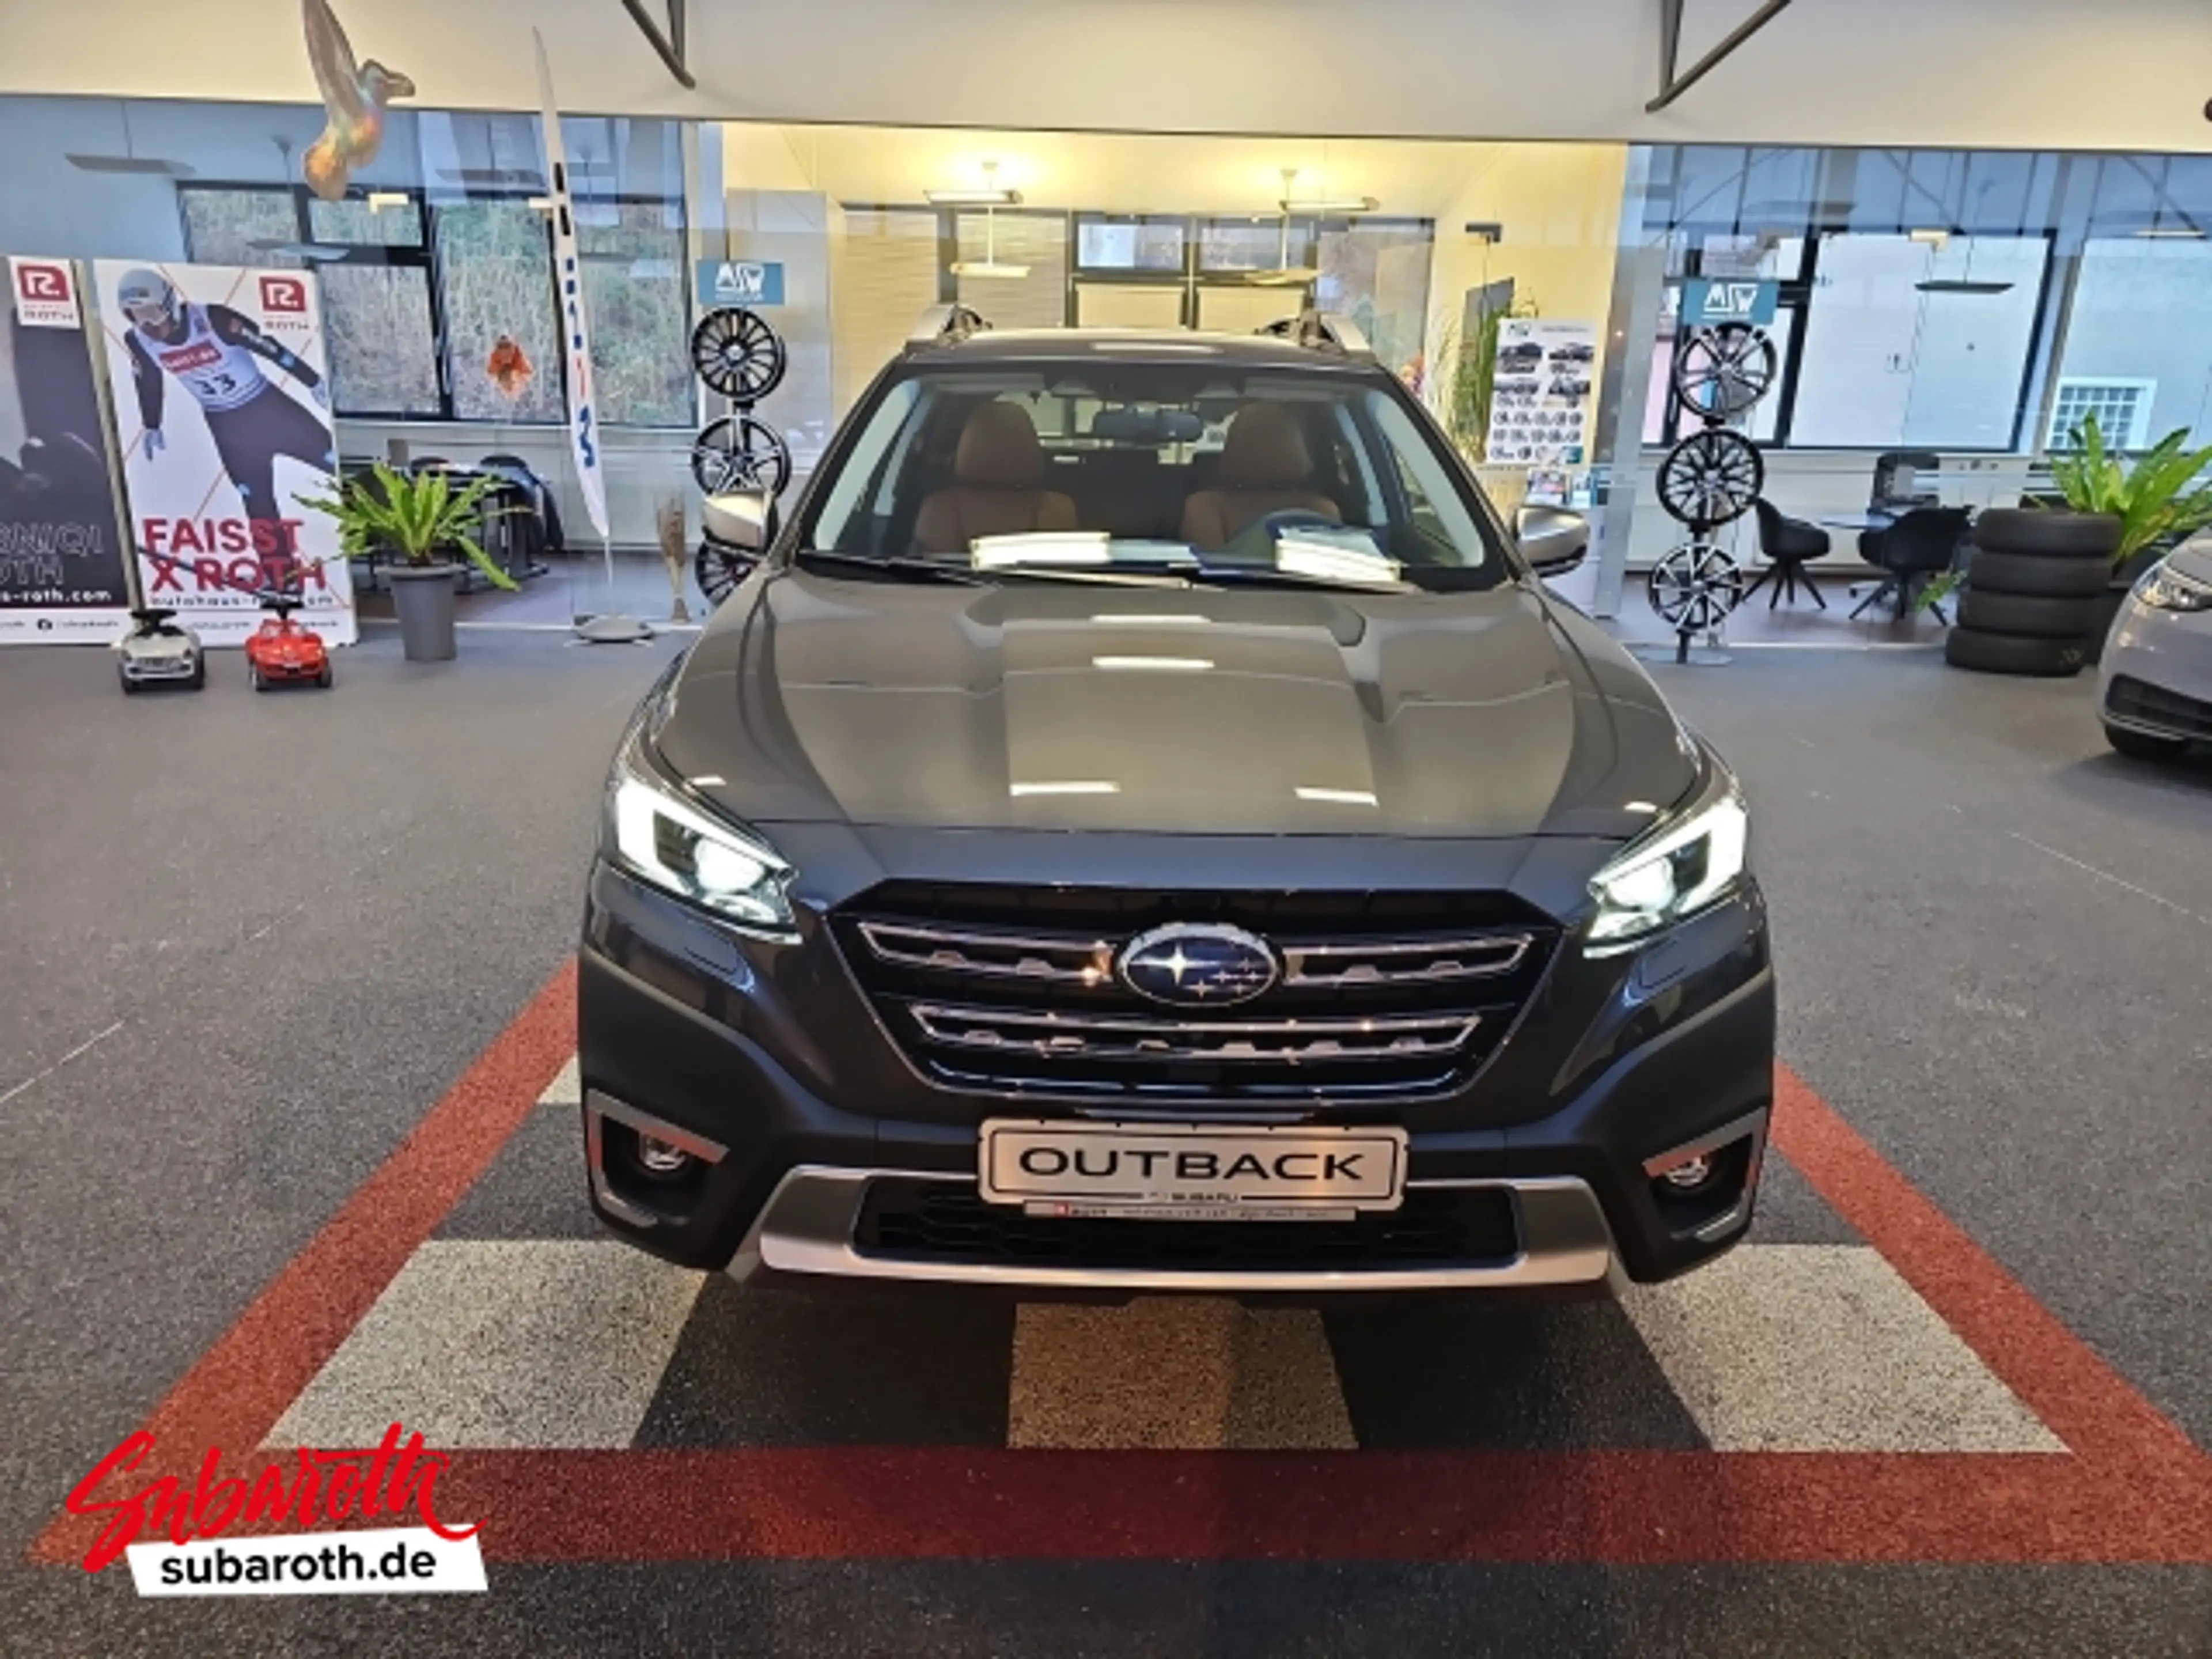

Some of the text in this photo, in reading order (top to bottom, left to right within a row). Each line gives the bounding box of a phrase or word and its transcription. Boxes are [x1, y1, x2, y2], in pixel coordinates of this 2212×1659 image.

[142, 518, 304, 553] FAISST
[149, 556, 327, 593] X ROTH
[1018, 1146, 1365, 1180] OUTBACK
